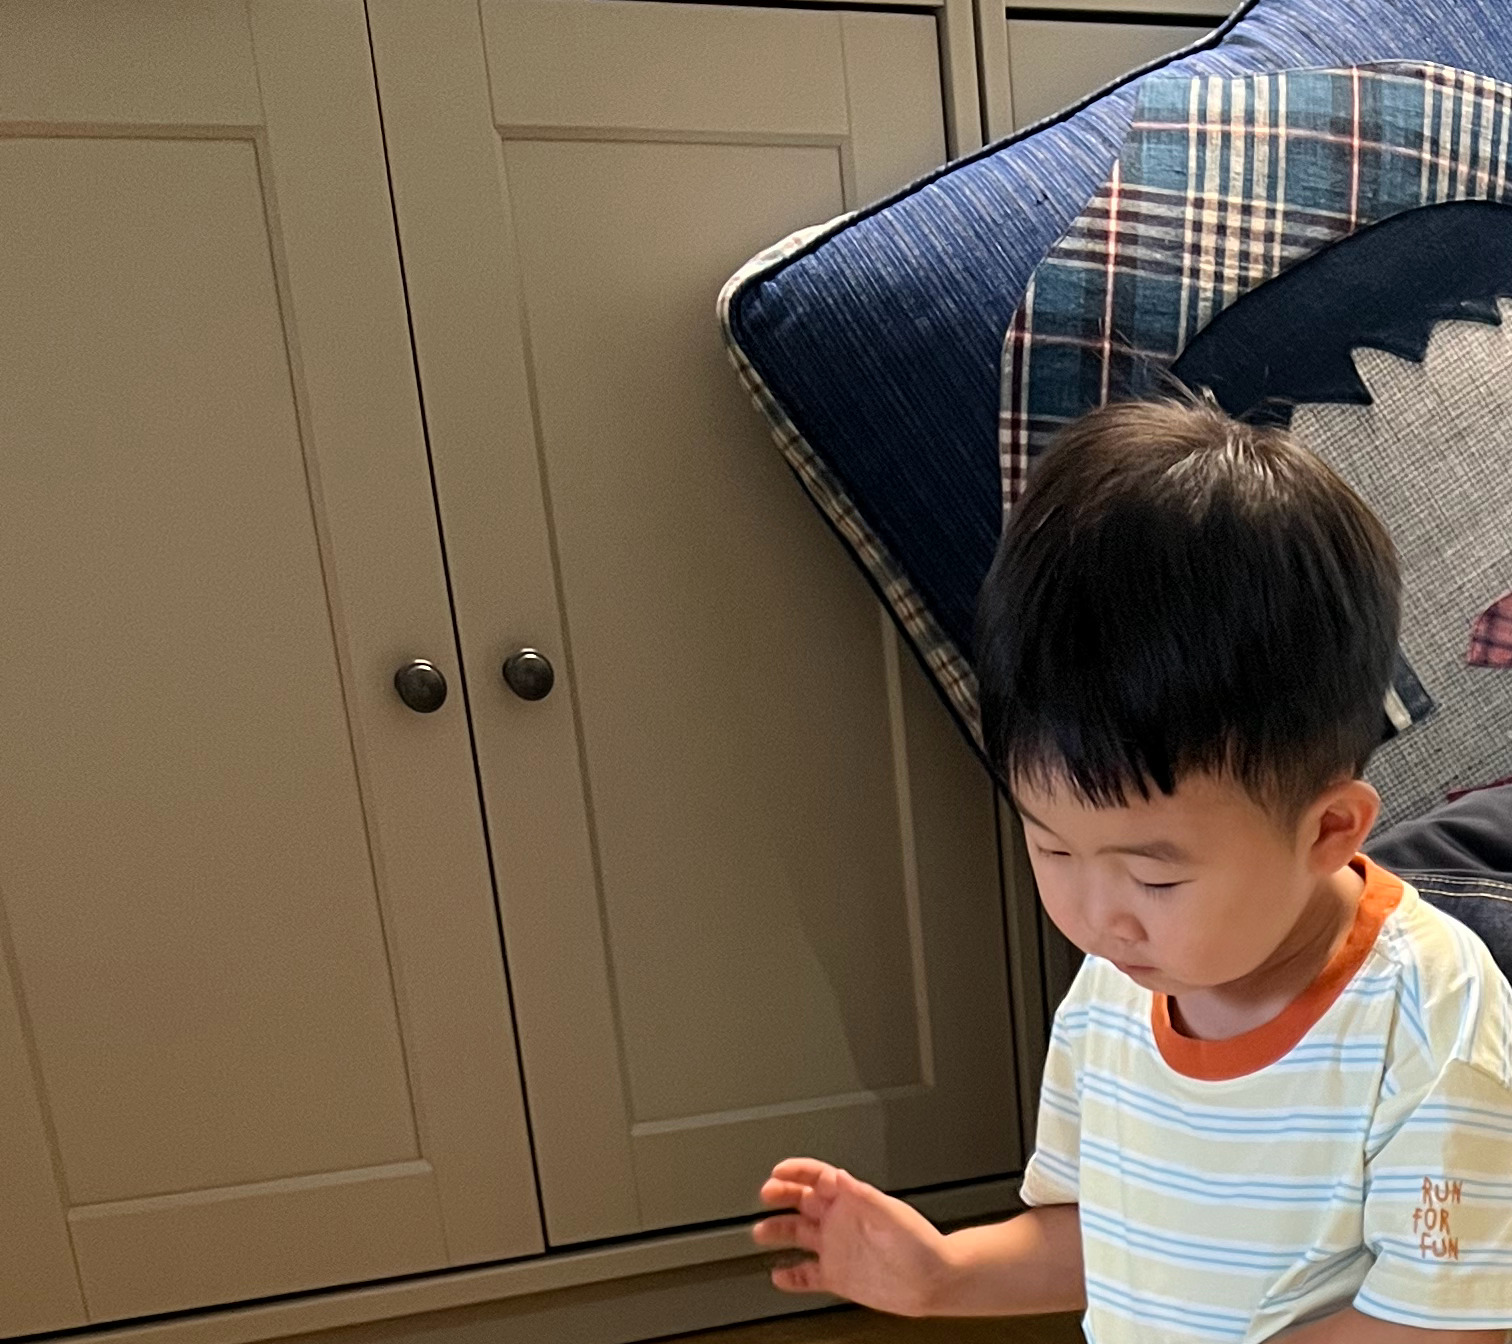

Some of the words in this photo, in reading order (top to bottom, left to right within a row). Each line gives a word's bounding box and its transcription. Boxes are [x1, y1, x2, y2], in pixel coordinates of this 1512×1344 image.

[1422, 1176, 1463, 1205] RUN
[1412, 1208, 1450, 1233] FOR
[1419, 1232, 1459, 1260] FUN
